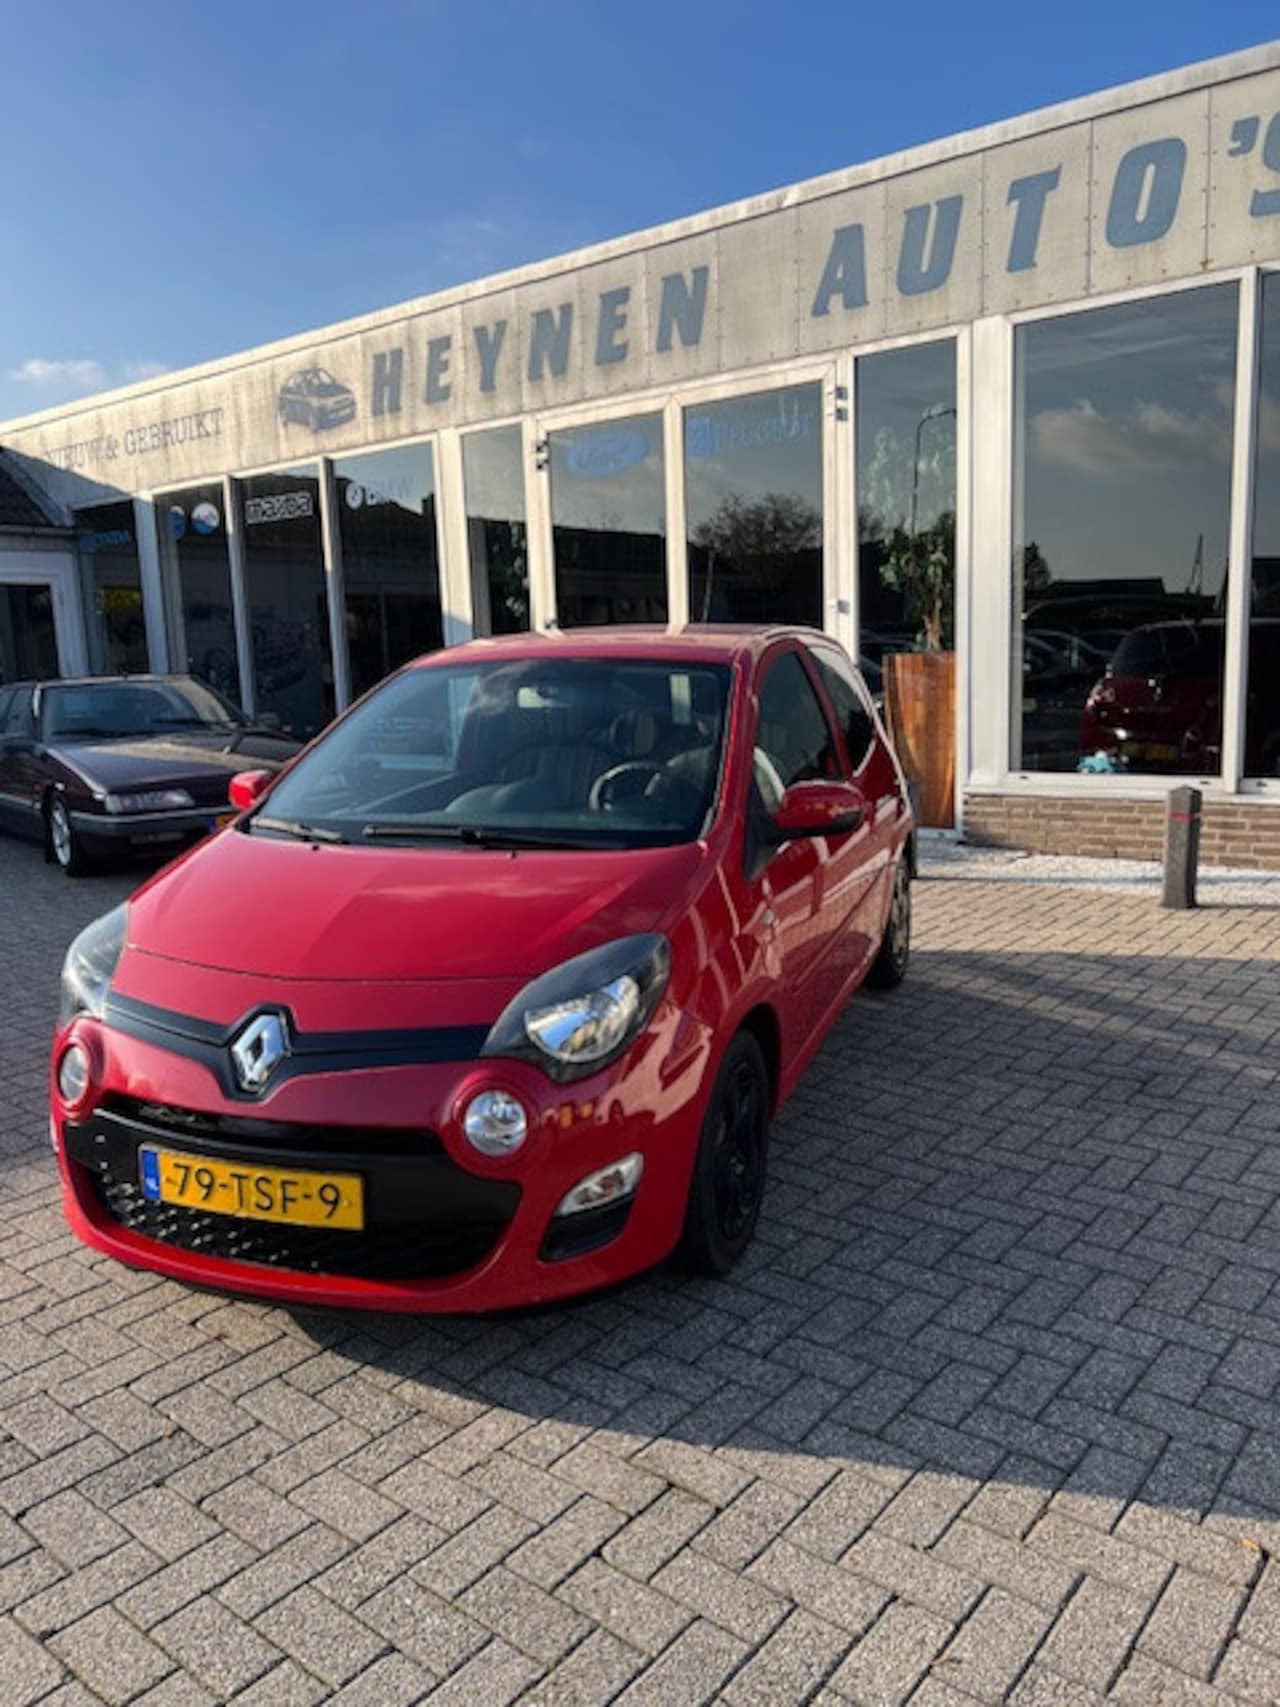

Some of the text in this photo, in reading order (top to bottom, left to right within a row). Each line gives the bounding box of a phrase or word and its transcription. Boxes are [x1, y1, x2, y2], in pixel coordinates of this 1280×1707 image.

[371, 265, 708, 416] HEYNEN
[124, 407, 224, 455] GEBRUIKT
[173, 1162, 341, 1219] 79-TSF-9
